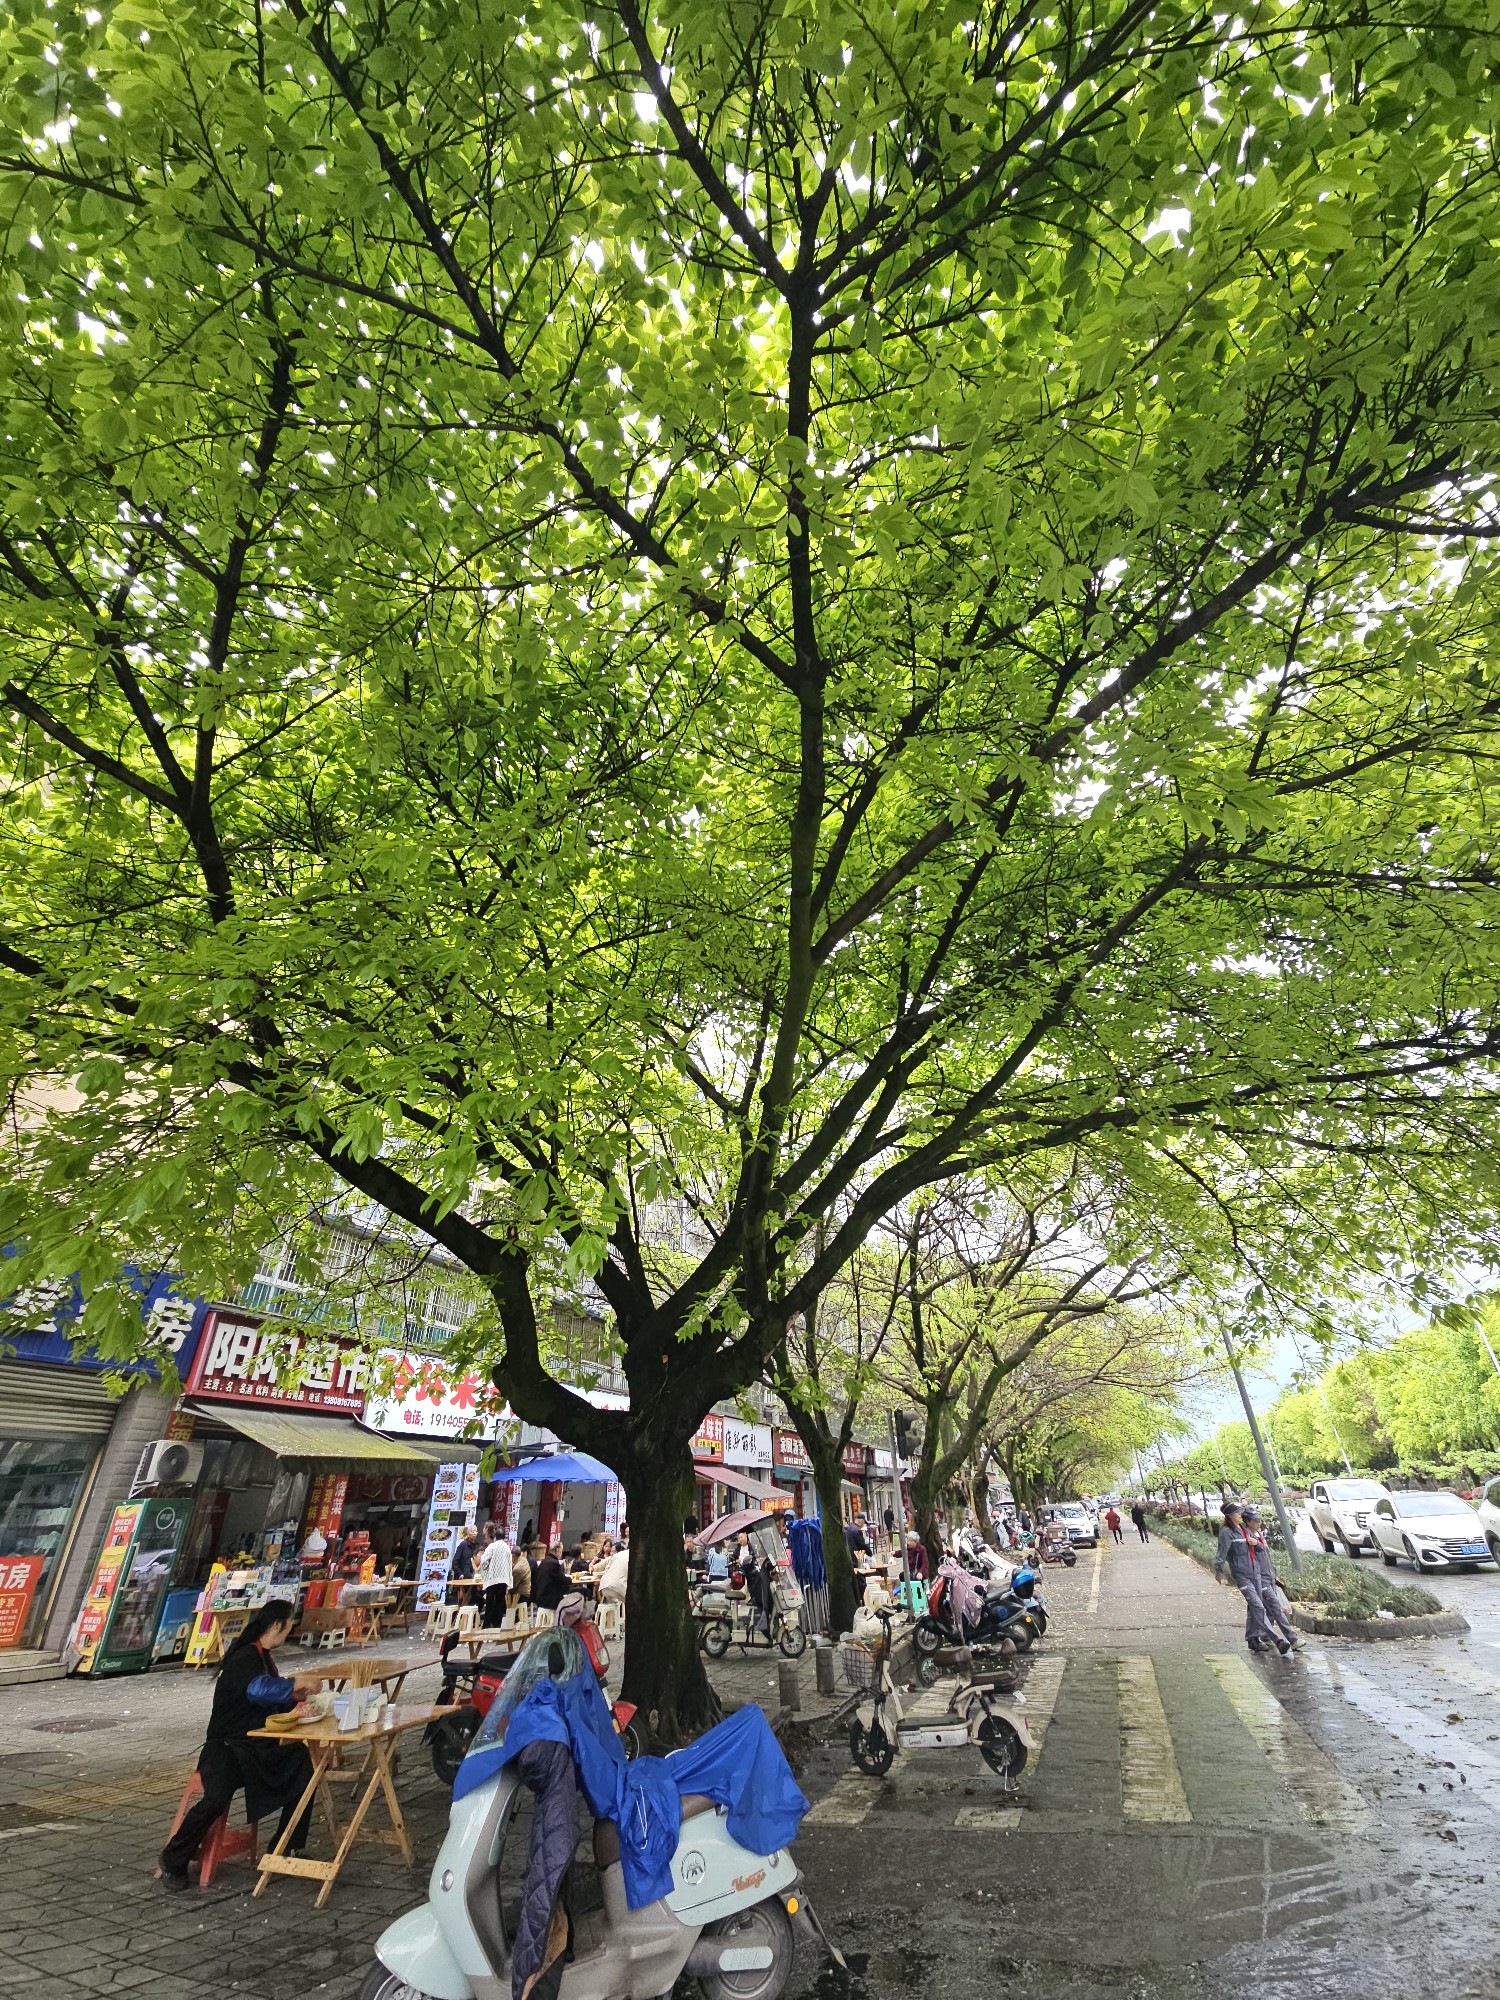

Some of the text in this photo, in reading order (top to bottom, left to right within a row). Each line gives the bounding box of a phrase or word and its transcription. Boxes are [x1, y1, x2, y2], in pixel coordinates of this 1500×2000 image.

[204, 1322, 370, 1394] 阳阳超市
[255, 1385, 269, 1397] 饮料
